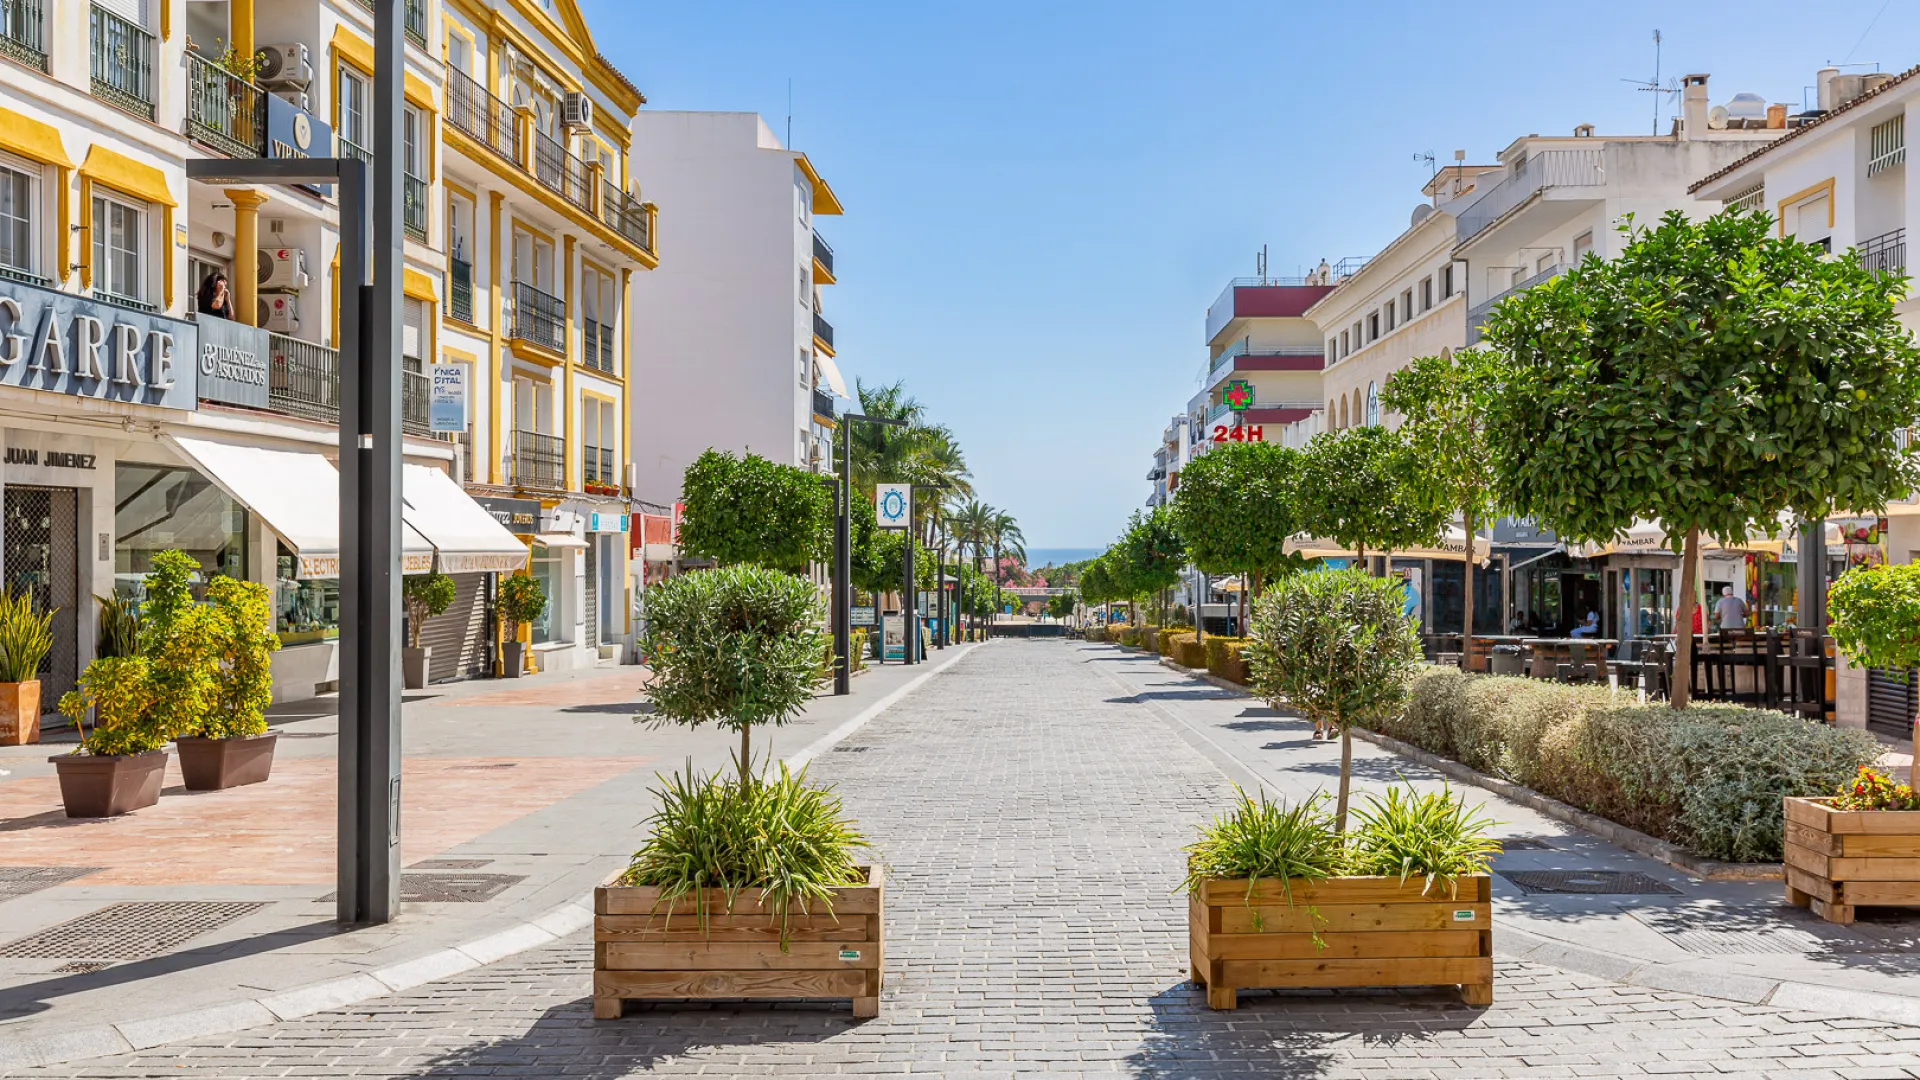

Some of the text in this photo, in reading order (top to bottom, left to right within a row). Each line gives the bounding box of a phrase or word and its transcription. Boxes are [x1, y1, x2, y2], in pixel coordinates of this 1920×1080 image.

[216, 363, 266, 385] ASOCIADOS
[1213, 425, 1263, 442] 24H
[4, 448, 97, 470] JUAN JIMENEZ
